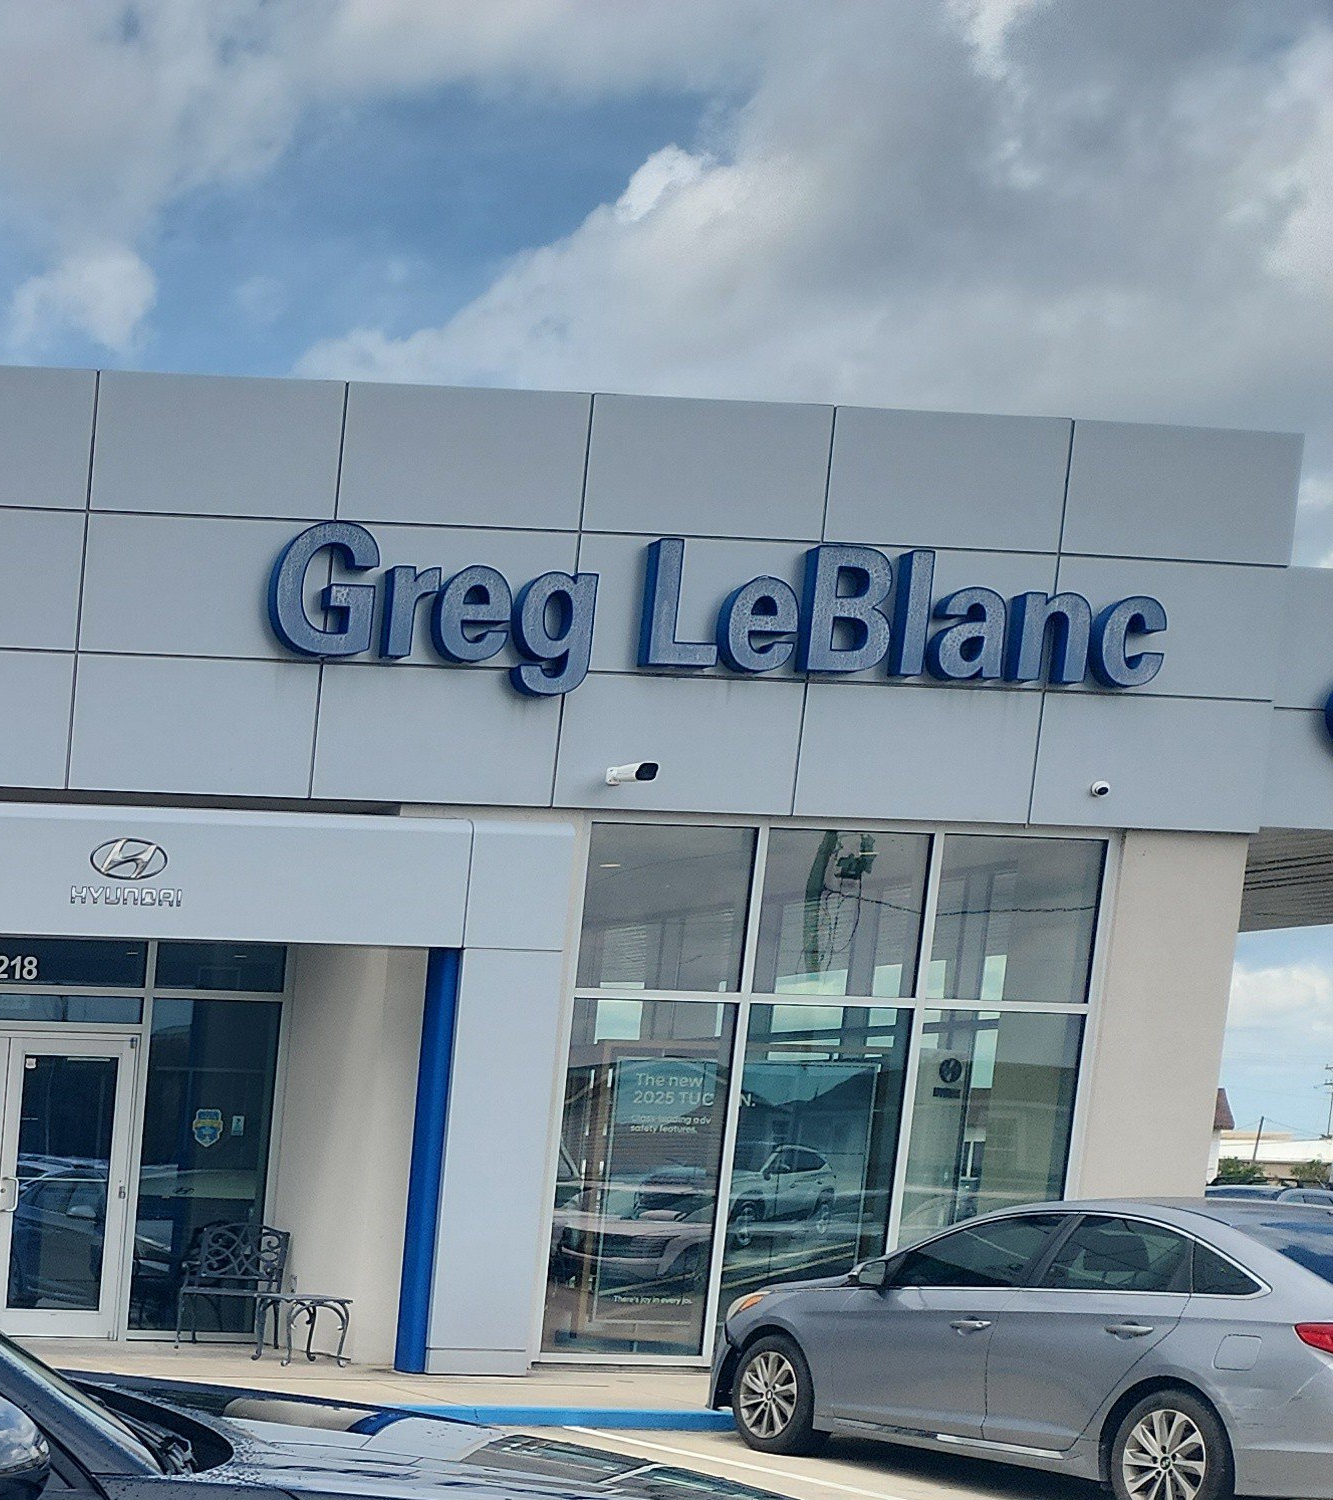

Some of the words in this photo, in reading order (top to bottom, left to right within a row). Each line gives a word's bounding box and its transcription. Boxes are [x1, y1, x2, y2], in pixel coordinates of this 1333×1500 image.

[268, 520, 599, 697] Greg
[638, 536, 1169, 690] LeBlanc
[70, 885, 183, 908] HYUNDAI
[636, 1072, 666, 1087] The
[668, 1075, 704, 1088] new
[633, 1090, 675, 1105] 2025
[630, 1124, 658, 1134] safety
